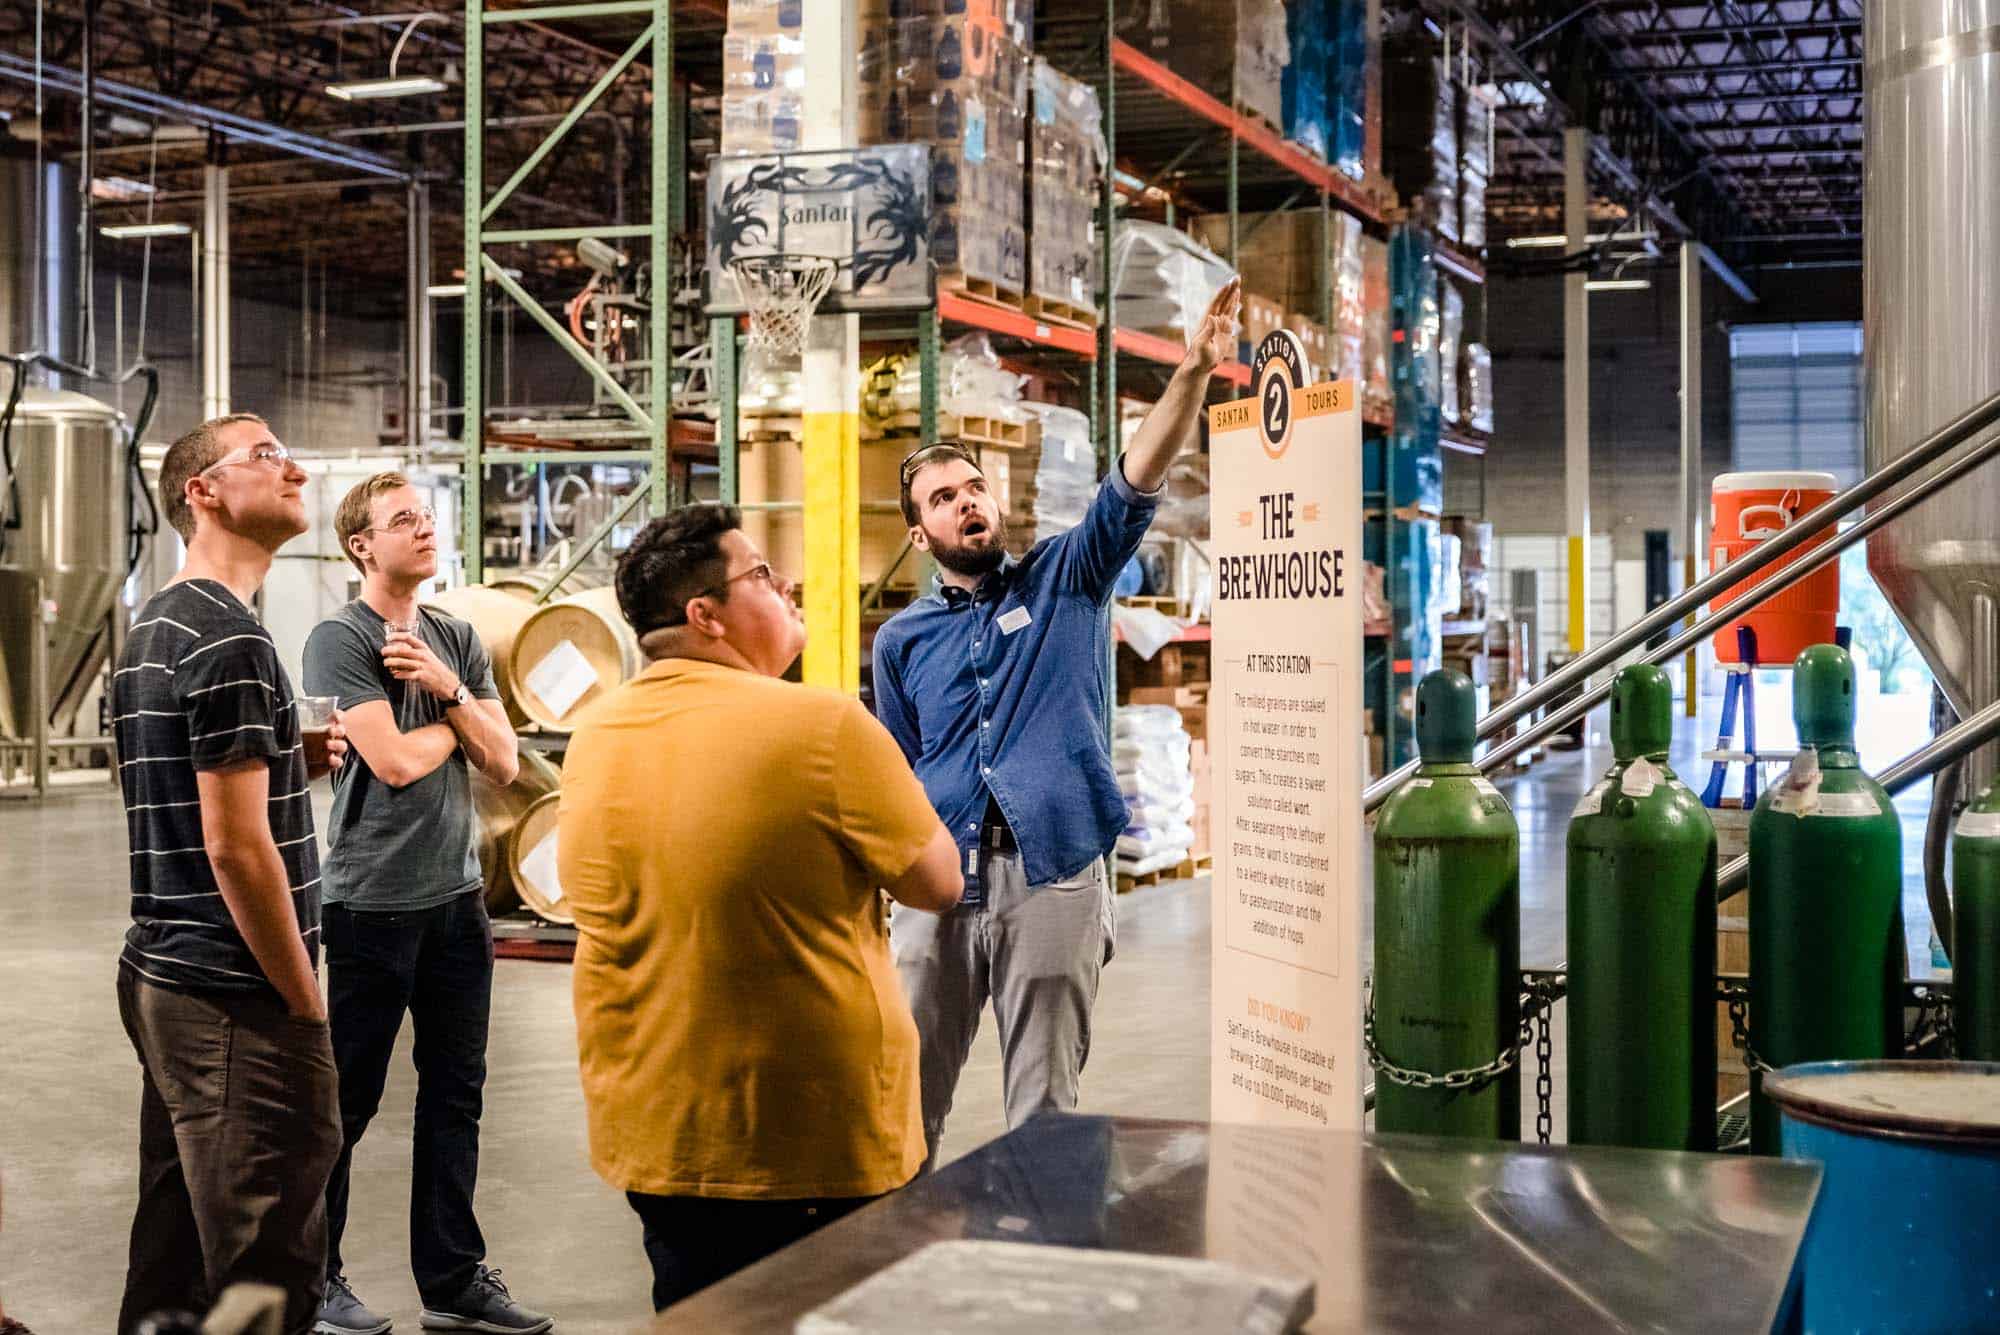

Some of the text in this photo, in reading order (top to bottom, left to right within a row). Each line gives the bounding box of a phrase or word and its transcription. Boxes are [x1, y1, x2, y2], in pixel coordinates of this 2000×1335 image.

[1256, 336, 1297, 373] STATION
[1269, 382, 1282, 432] 2
[1306, 389, 1338, 411] TOURS
[1216, 406, 1249, 428] SANTAN
[1259, 492, 1295, 540] THE
[1219, 549, 1344, 600] BREWHOUSE
[1246, 654, 1311, 675] AT THIS STATION
[1234, 692, 1326, 713] The milled grains are soaked
[1250, 721, 1260, 734] hot
[1262, 722, 1280, 736] water
[1281, 724, 1289, 735] in
[1290, 724, 1307, 738] order
[1309, 726, 1317, 739] to
[1241, 745, 1320, 766] convert the starches into
[1258, 768, 1272, 785] This
[1273, 773, 1297, 788] creates
[1305, 777, 1326, 793] sweet
[1247, 794, 1272, 810] solution
[1273, 798, 1293, 813] called
[1236, 815, 1326, 846] After separating the leftover
[1254, 844, 1265, 859] the
[1267, 847, 1281, 862] wort
[1283, 850, 1289, 864] is
[1290, 851, 1329, 872] transferred
[1236, 866, 1243, 880] to
[1250, 868, 1268, 885] kettle
[1269, 872, 1289, 889] where
[1305, 880, 1326, 897] boiled
[1239, 889, 1322, 923] for pasteurization and the
[1253, 919, 1279, 937] addition
[1280, 924, 1287, 939] of
[1247, 998, 1312, 1033] DID YOU KNOW?
[1256, 1029, 1291, 1056] Brewhouse
[1292, 1043, 1299, 1058] is
[1299, 1046, 1326, 1069] capable
[1327, 1055, 1336, 1072] of
[1231, 1071, 1244, 1088] and
[1245, 1078, 1252, 1093] up
[1253, 1079, 1261, 1096] to
[1285, 1093, 1309, 1115] gallons
[1275, 1063, 1299, 1085] gallons
[1299, 1073, 1312, 1089] per
[1313, 1075, 1333, 1096] batch
